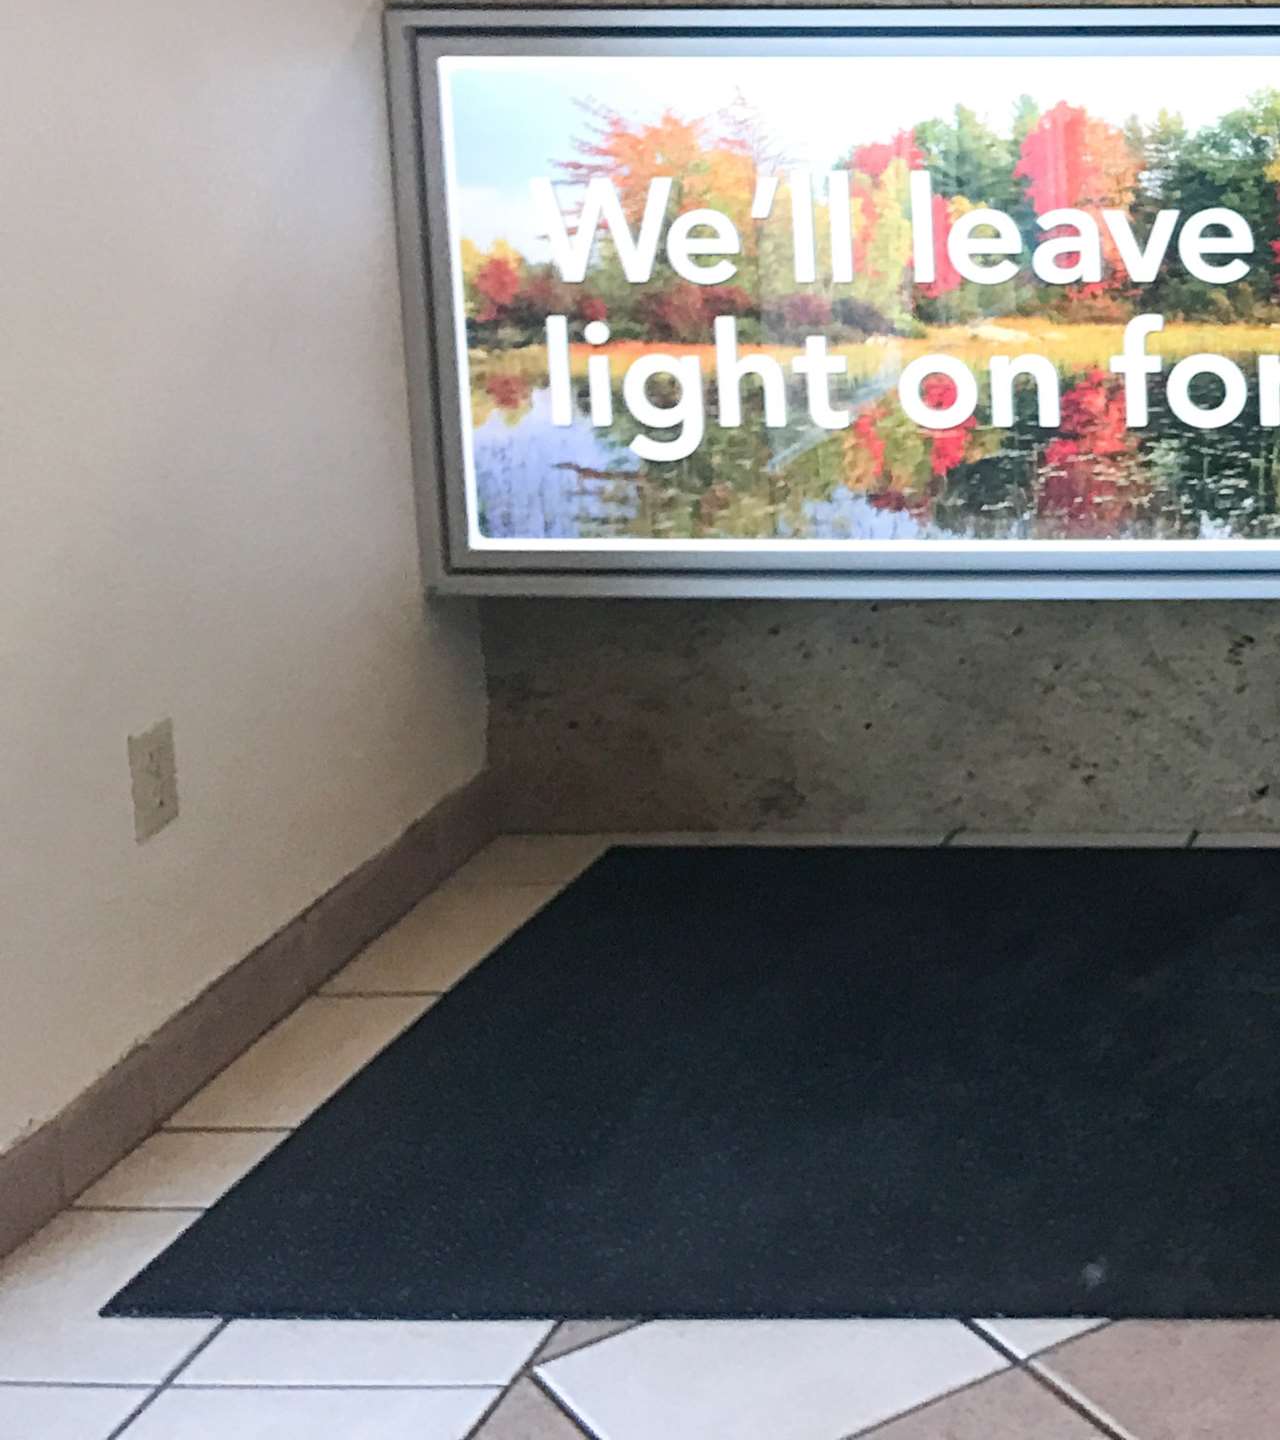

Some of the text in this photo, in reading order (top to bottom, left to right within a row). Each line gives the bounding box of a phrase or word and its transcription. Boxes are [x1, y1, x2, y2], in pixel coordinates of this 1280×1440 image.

[529, 170, 854, 285] We'll
[909, 170, 1255, 286] leave
[545, 314, 851, 462] light
[899, 352, 1062, 431] on
